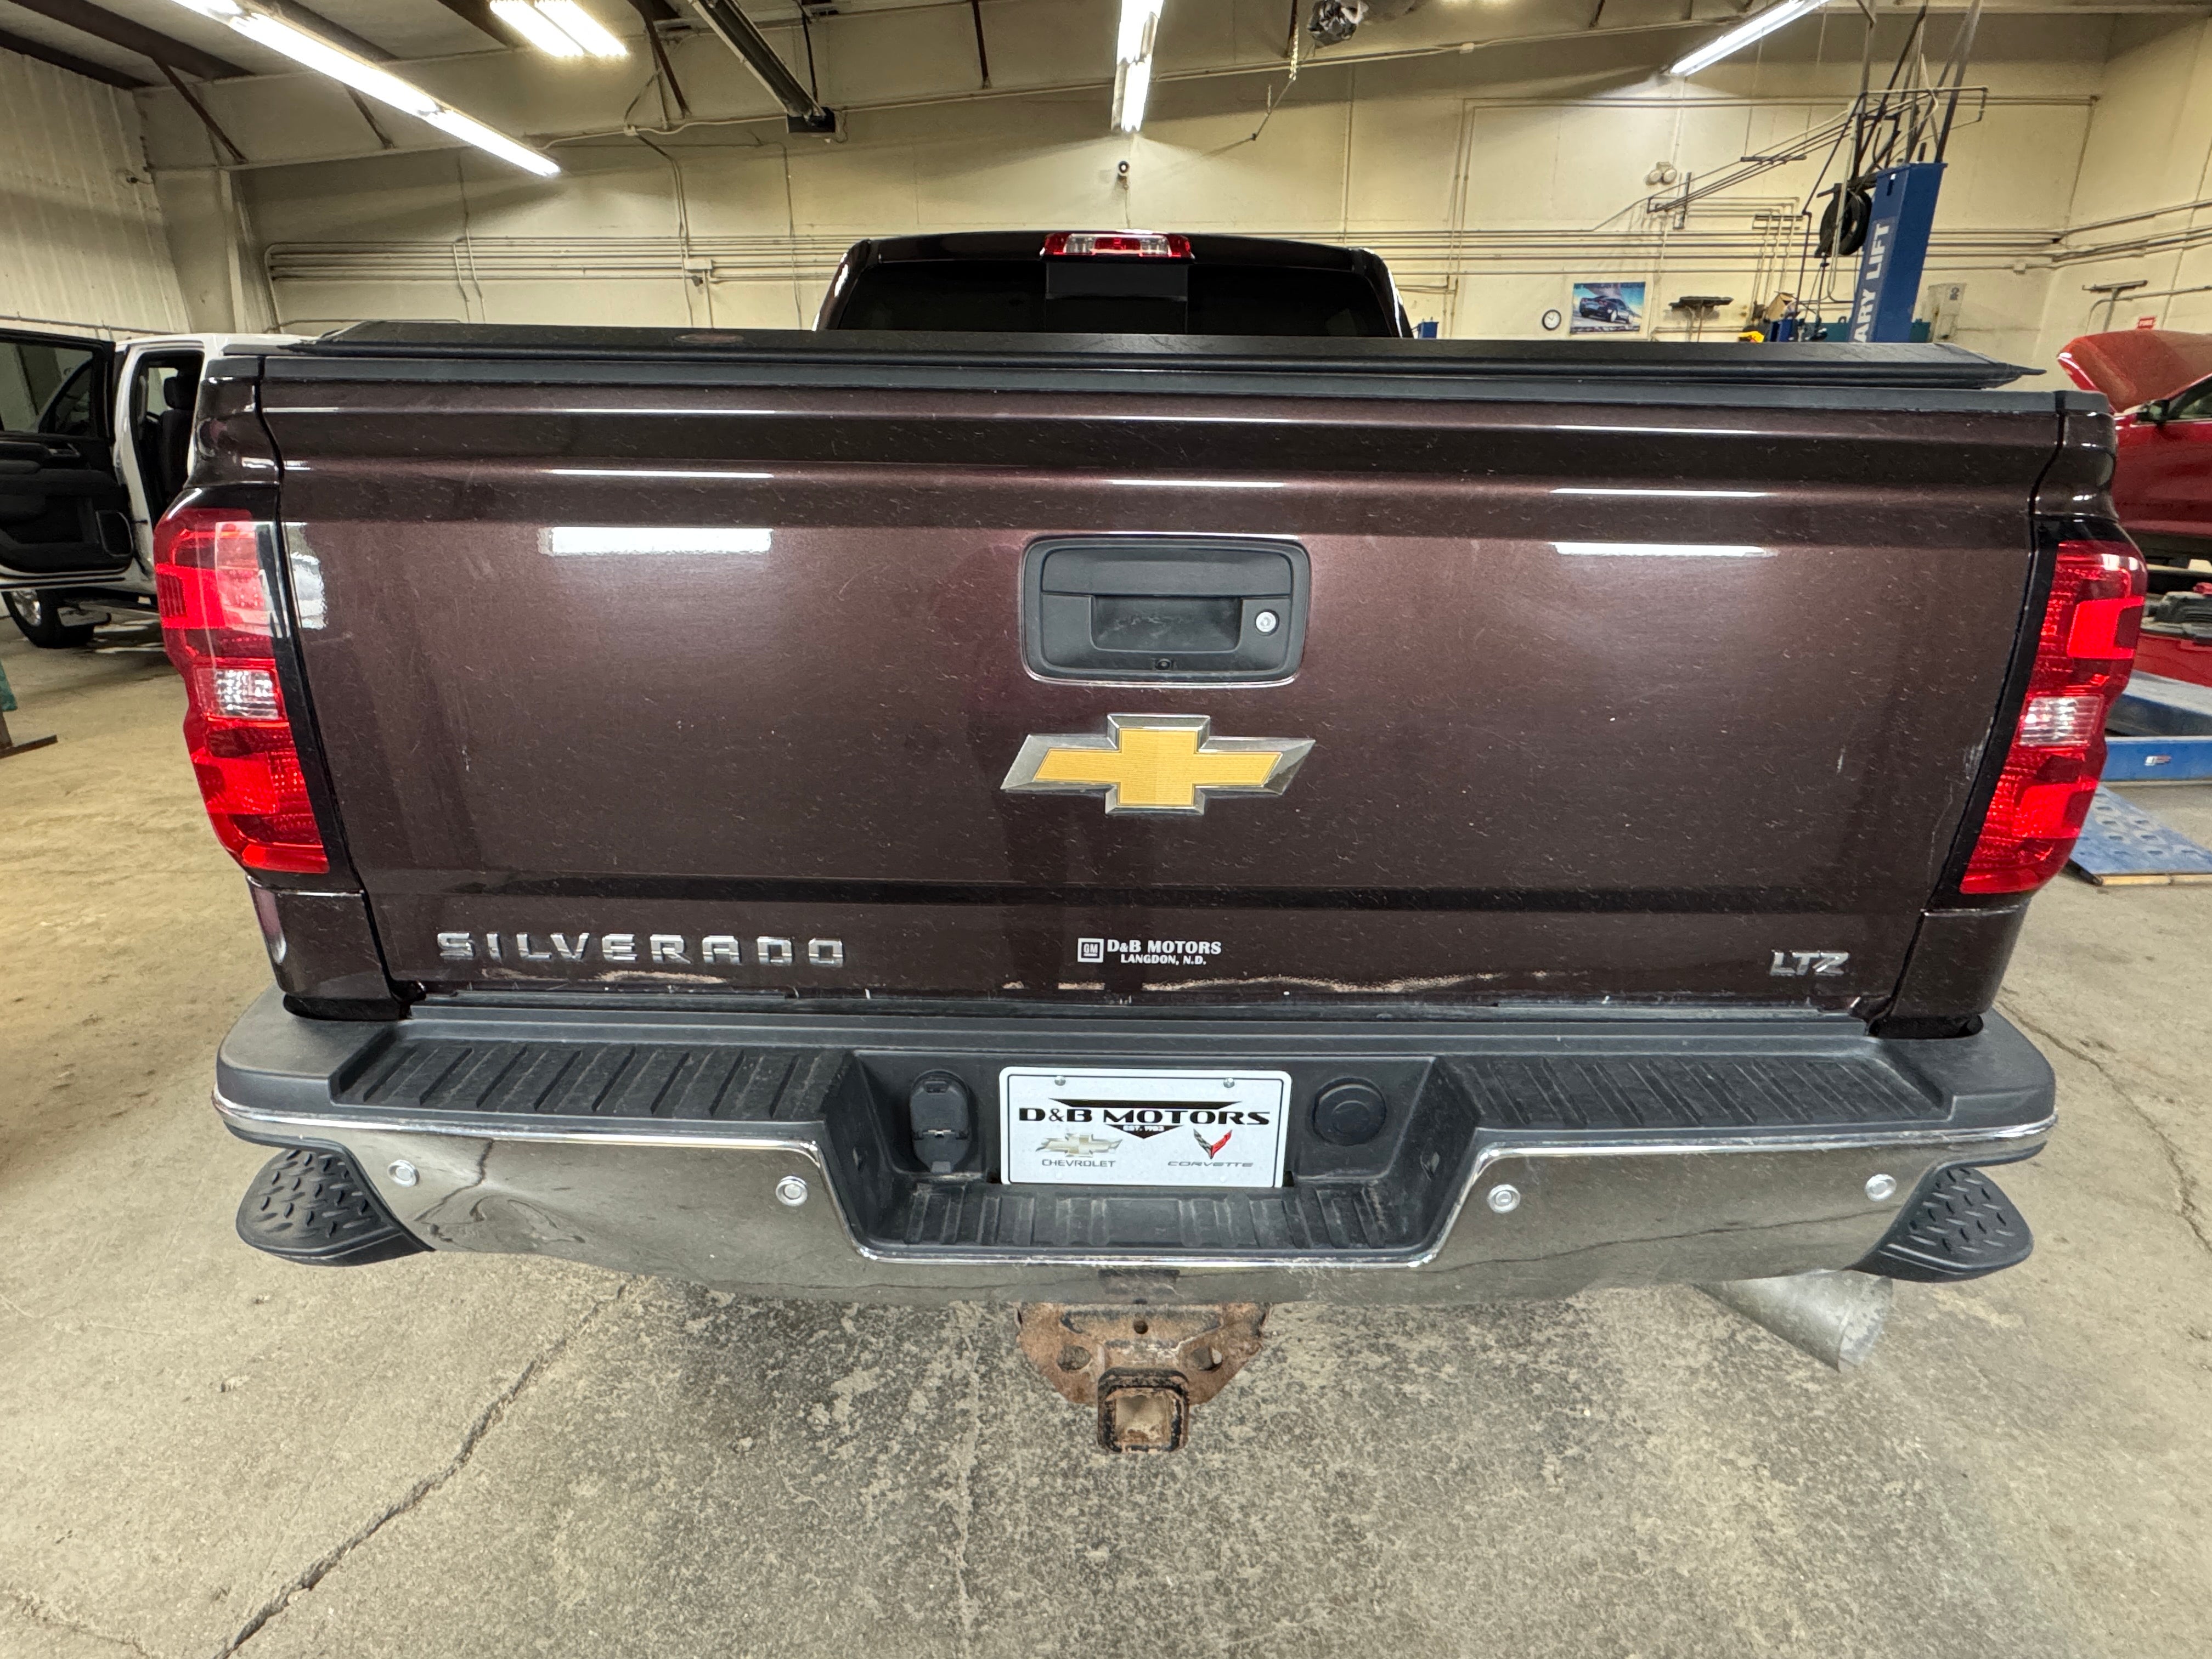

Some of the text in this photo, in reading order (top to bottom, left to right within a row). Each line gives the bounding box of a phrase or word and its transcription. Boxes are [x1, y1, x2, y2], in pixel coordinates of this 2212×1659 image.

[1866, 223, 1889, 280] LIFT
[437, 932, 845, 967] SILVERADO
[1107, 939, 1222, 955] D&B MOTORS
[1120, 953, 1207, 966] LANGDON, N.D.
[1769, 949, 1849, 976] LTZ
[1019, 1107, 1271, 1126] D&B MOTORS
[1041, 1159, 1116, 1167] CHEVROLET
